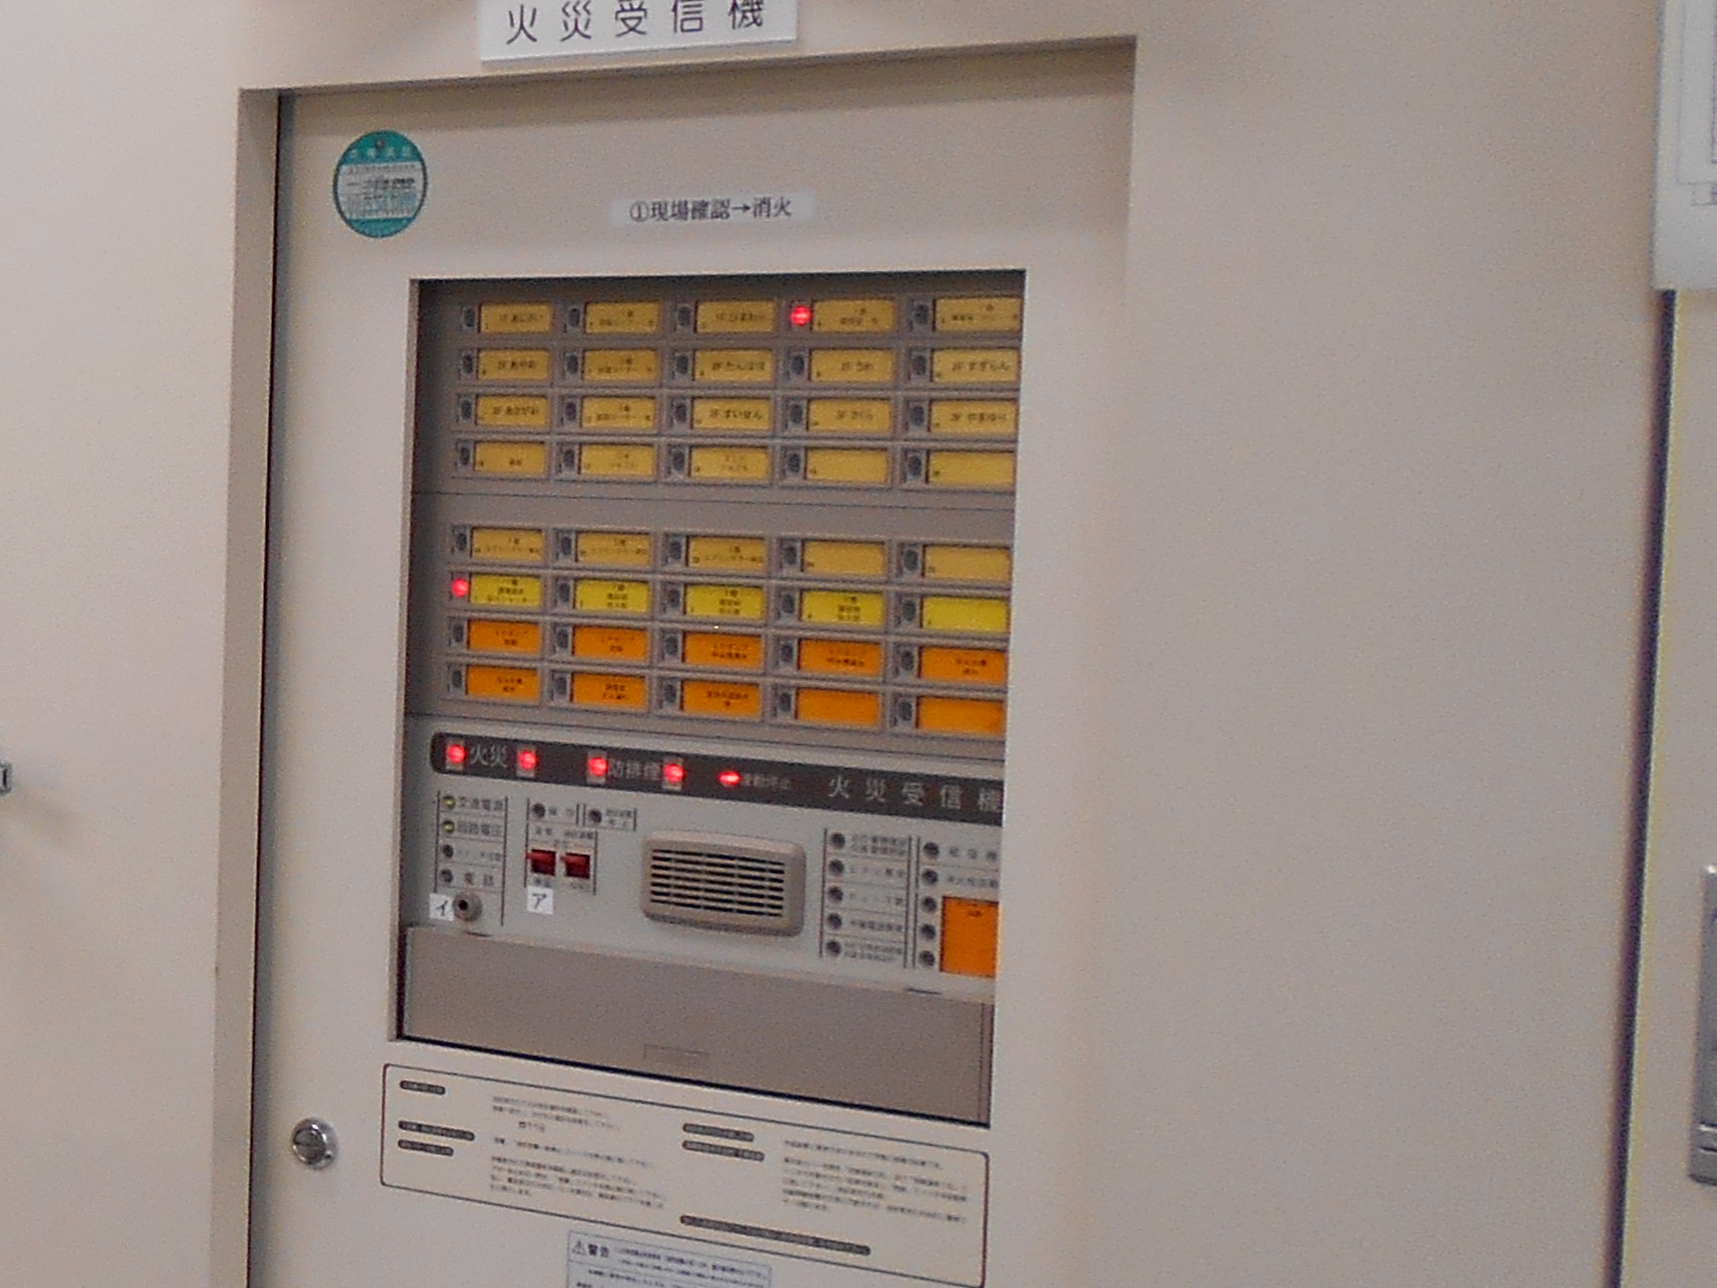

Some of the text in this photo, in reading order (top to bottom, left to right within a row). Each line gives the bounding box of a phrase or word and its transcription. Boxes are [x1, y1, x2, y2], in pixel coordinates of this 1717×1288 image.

[469, 744, 509, 768] 火災
[828, 774, 1001, 811] 火災受信機
[435, 898, 449, 917] イ
[530, 892, 548, 911] ア
